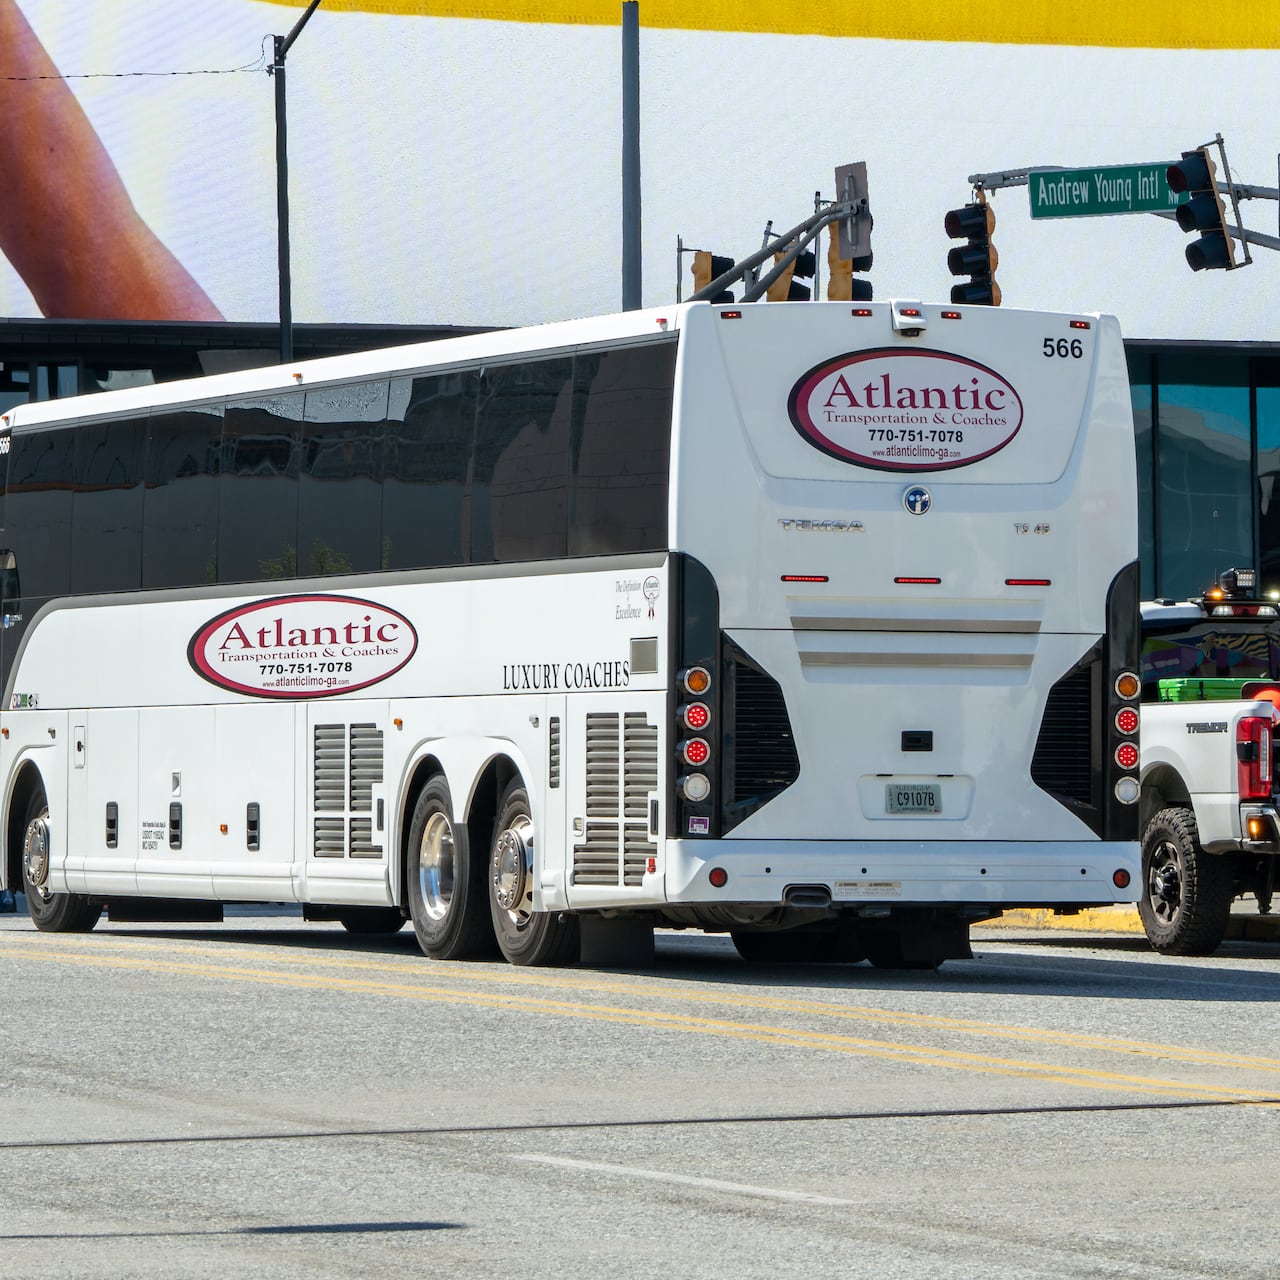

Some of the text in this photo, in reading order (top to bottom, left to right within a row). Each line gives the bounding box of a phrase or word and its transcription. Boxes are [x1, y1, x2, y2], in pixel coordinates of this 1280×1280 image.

[1038, 177, 1089, 206] Andrew
[1095, 174, 1132, 210] Young
[1138, 169, 1160, 200] Intl
[1168, 191, 1179, 205] NW
[1043, 337, 1083, 359] 566
[824, 373, 1006, 411] Atlantic
[824, 410, 1007, 426] Transportation & Coaches
[868, 429, 964, 443] 770-751-7078
[872, 446, 961, 459] www.atlanticlimo-ga.com
[778, 519, 865, 532] TEMSA
[218, 615, 399, 651] Atlantic
[218, 645, 399, 663] Transportation & Coaches
[259, 661, 353, 675] 770-751-7078
[503, 660, 630, 690] LUXURY COACHES
[262, 676, 350, 688] www.atlanticlimo-ga.com
[1186, 721, 1228, 734] TREMOR
[897, 792, 935, 806] C9107B
